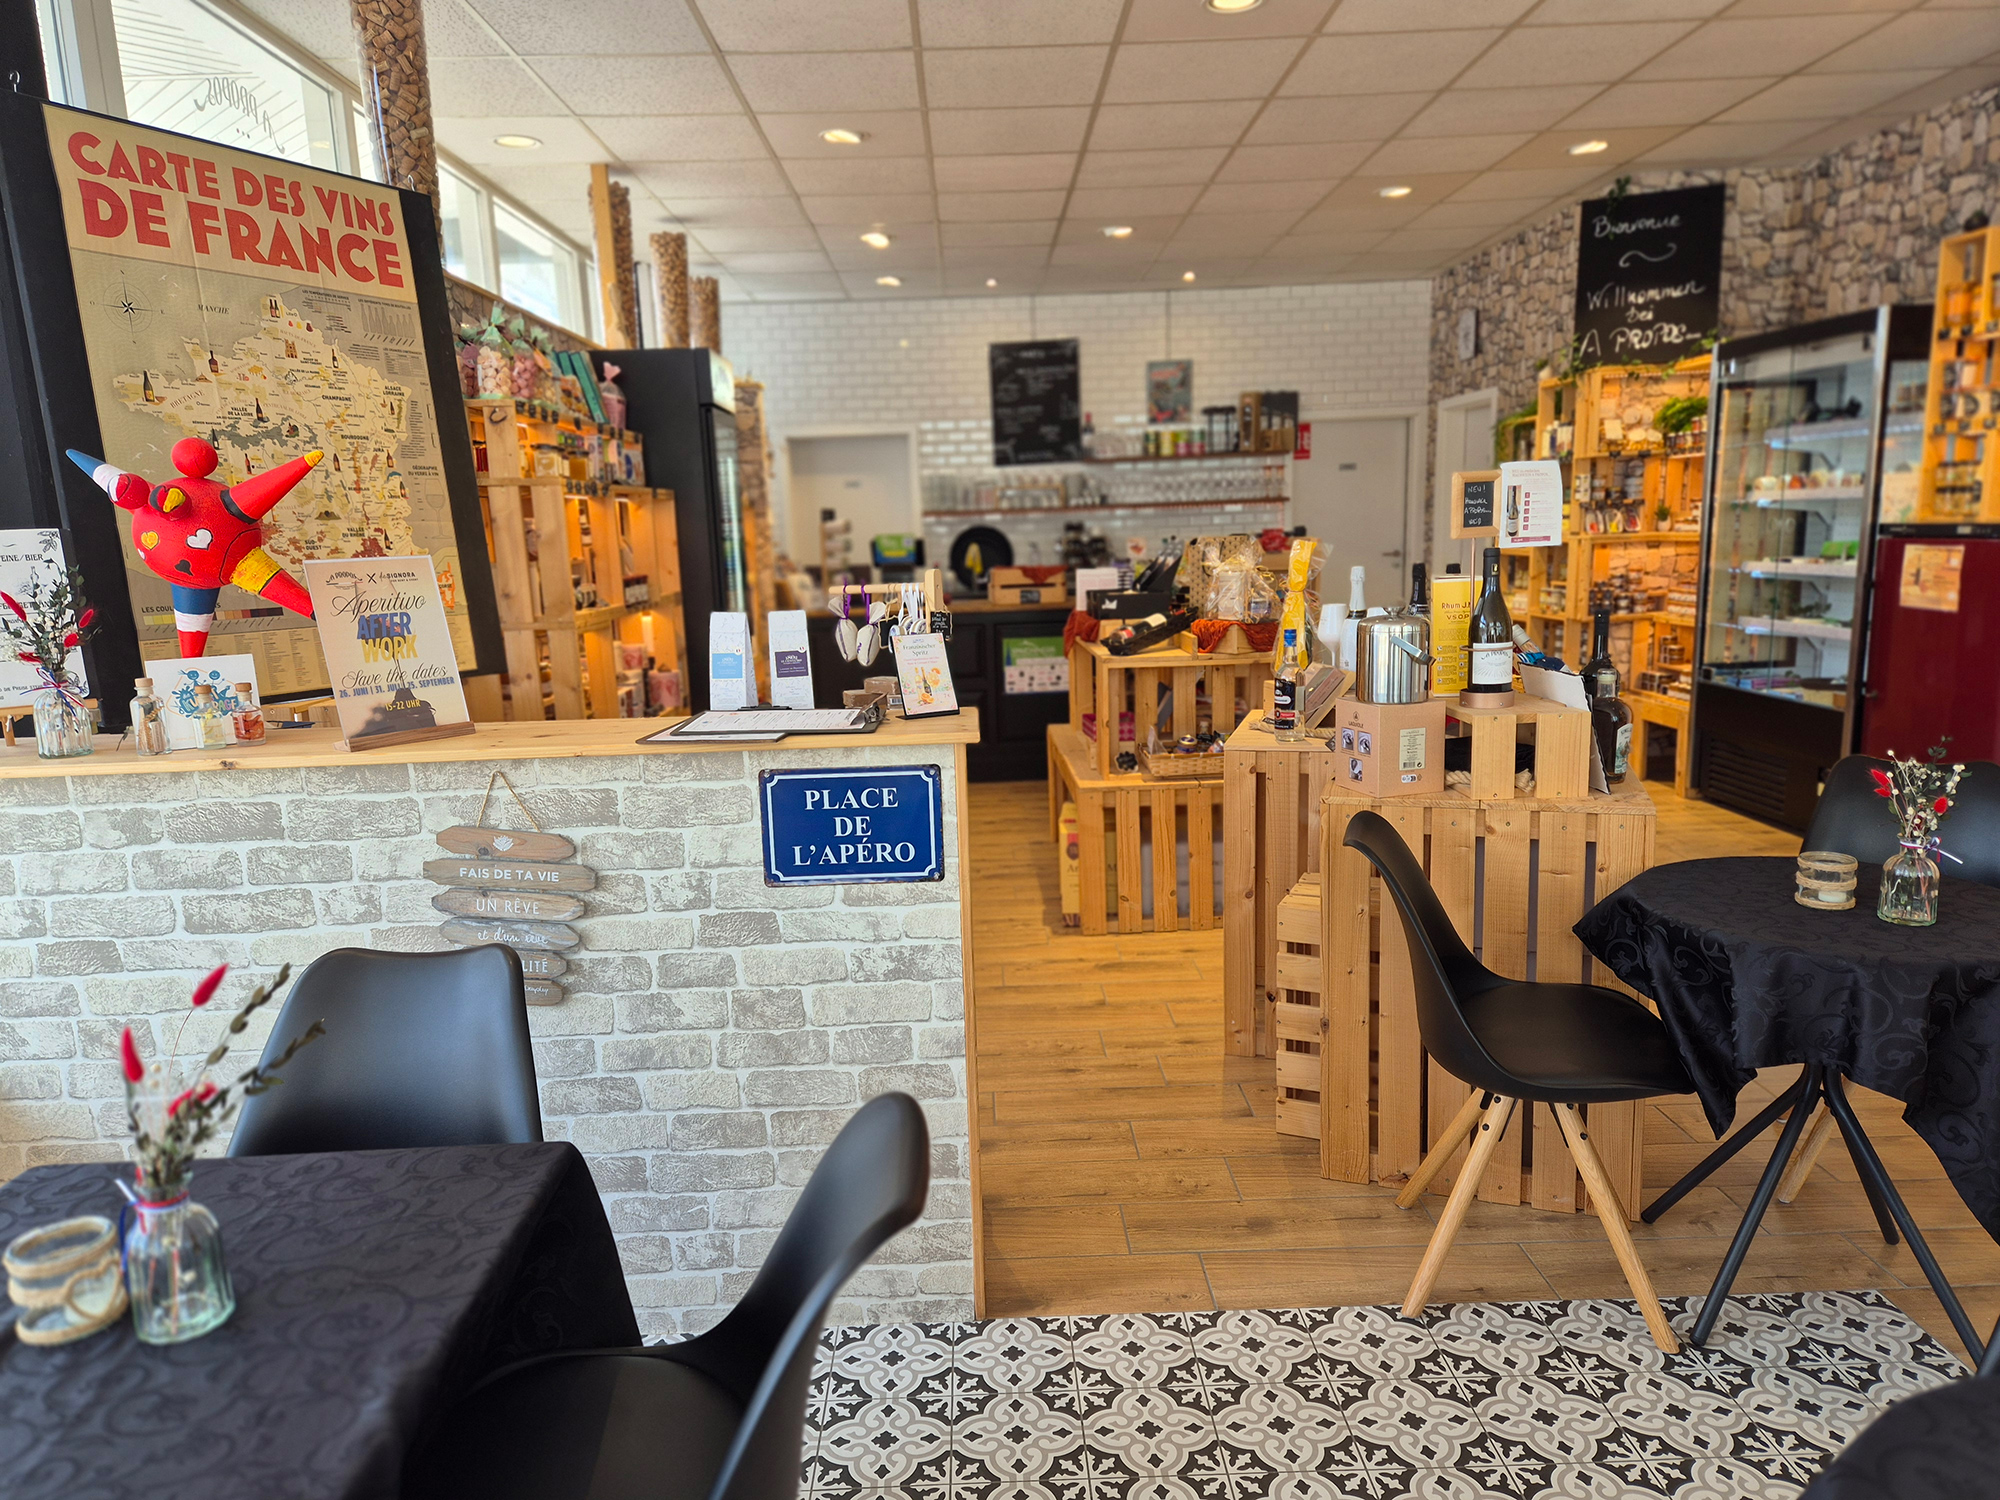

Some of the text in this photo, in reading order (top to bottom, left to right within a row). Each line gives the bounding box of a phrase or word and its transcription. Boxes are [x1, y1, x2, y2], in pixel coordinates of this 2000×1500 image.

[67, 131, 395, 236] CARTE DES VINS
[77, 178, 405, 288] DE FRANCE
[1587, 280, 1706, 310] Willkommen
[198, 304, 230, 315] MANCHE
[1579, 328, 1601, 358] A
[170, 389, 205, 408] BRETAGNE
[321, 394, 352, 402] CHAMPAGNE
[141, 606, 155, 614] LES
[330, 591, 427, 624] Aperitivo
[1441, 602, 1461, 610] Rhum
[357, 611, 412, 640] AFTER
[361, 634, 419, 664] WORK
[339, 689, 351, 698] 26.
[352, 687, 369, 697] JUNI
[375, 685, 385, 694] 31.
[407, 681, 418, 690] 25.
[419, 676, 455, 689] SEPTEMBER
[341, 662, 448, 690] Save the dates
[406, 699, 421, 709] UHR
[804, 787, 899, 810] PLACE
[833, 815, 872, 837] DE
[792, 838, 916, 866] L'APÉRO
[459, 867, 559, 882] FAIS DE TA VIE
[476, 898, 540, 915] UN RÊVE
[477, 929, 489, 941] et
[522, 958, 548, 973] LITÉ
